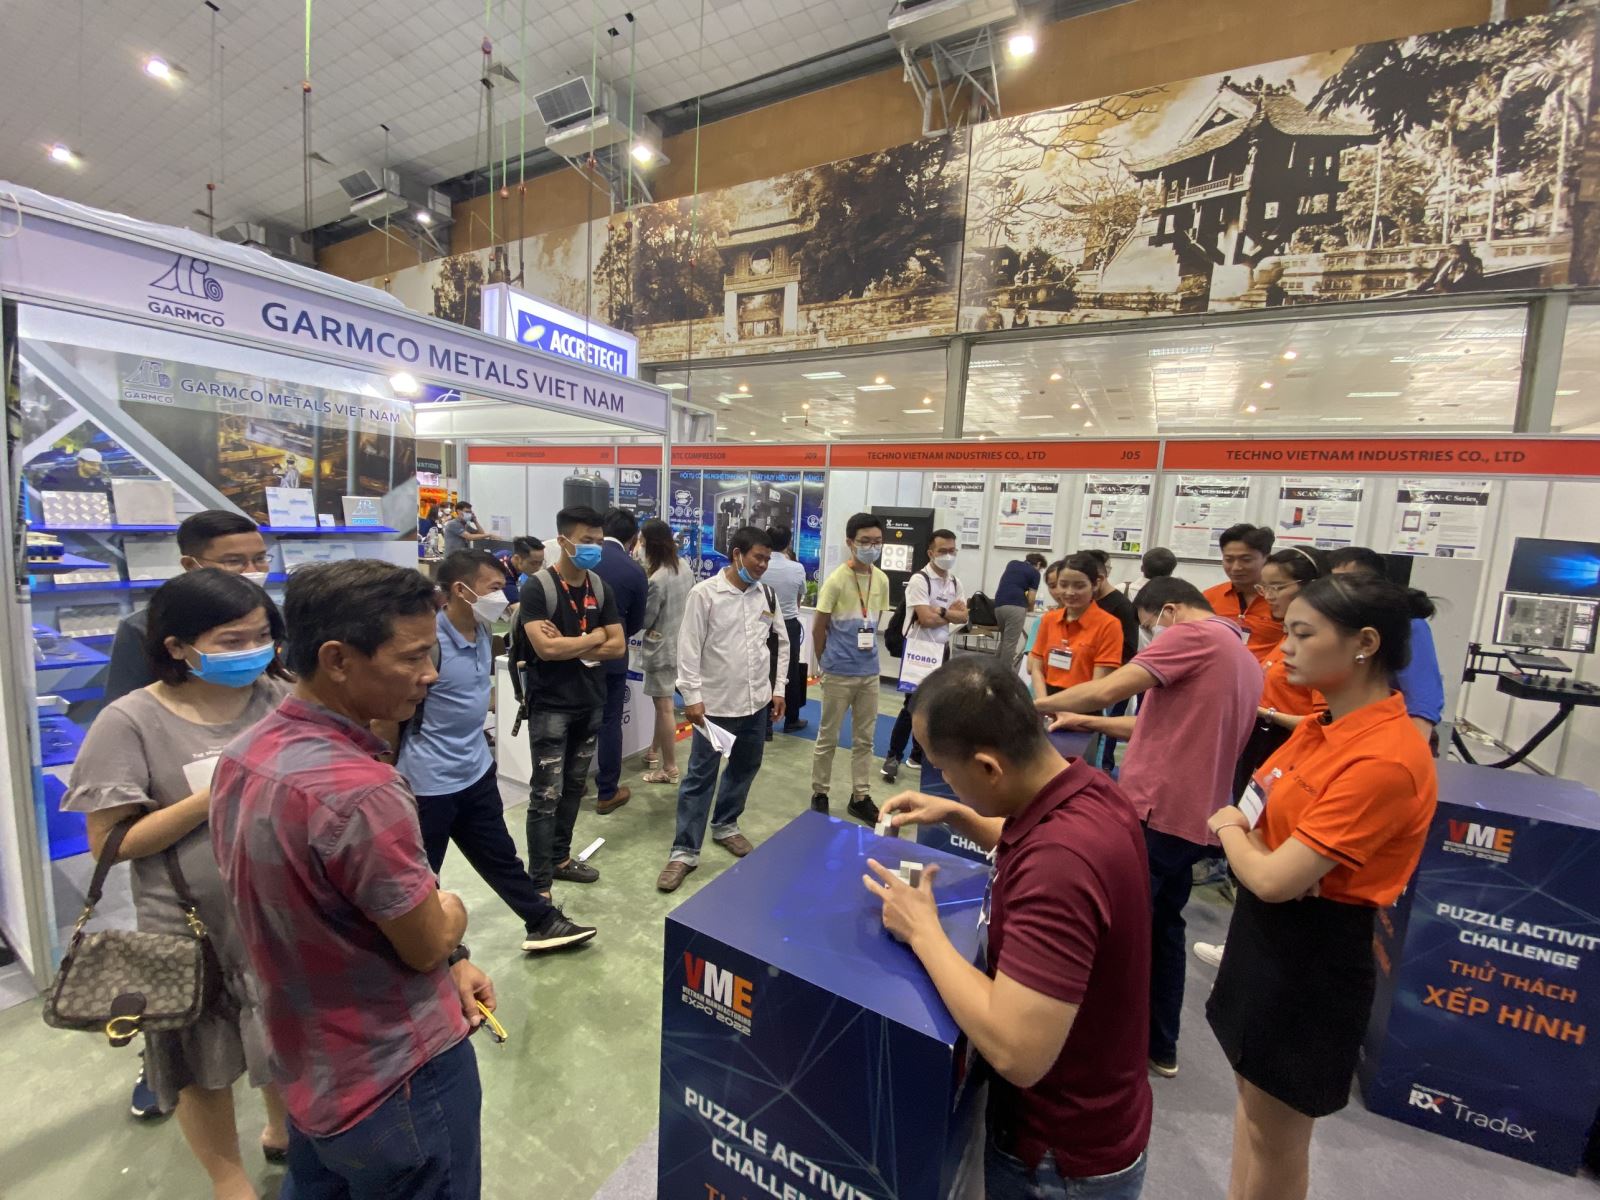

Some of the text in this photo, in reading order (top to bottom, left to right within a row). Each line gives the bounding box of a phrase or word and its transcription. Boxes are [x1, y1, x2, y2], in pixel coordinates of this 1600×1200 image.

[148, 301, 225, 327] GARMCO
[261, 302, 625, 413] GARMCO METALS VIET NAM
[549, 329, 624, 373] ACCRETECH
[124, 390, 173, 404] GARMCO
[180, 379, 401, 424] GARMCO METALS VIET NAM
[867, 451, 1047, 463] TECHNO VIETNAM INDUSTRIES CO., LTD
[1120, 450, 1141, 461] J05
[1226, 450, 1526, 464] TECHNO VIETNAM INDUSTRIES CO., LTD
[1448, 819, 1516, 854] VME
[1436, 902, 1515, 932] PUZZLE
[1458, 929, 1581, 970] CHALLENGE
[683, 950, 753, 1019] VME
[1449, 959, 1579, 1004] THỬ THÁCH
[681, 993, 752, 1037] EXPO 2022
[1423, 984, 1587, 1046] XẾP HÌNH
[684, 1086, 768, 1155] PUZZLE
[1408, 1089, 1537, 1143] RX Tradex
